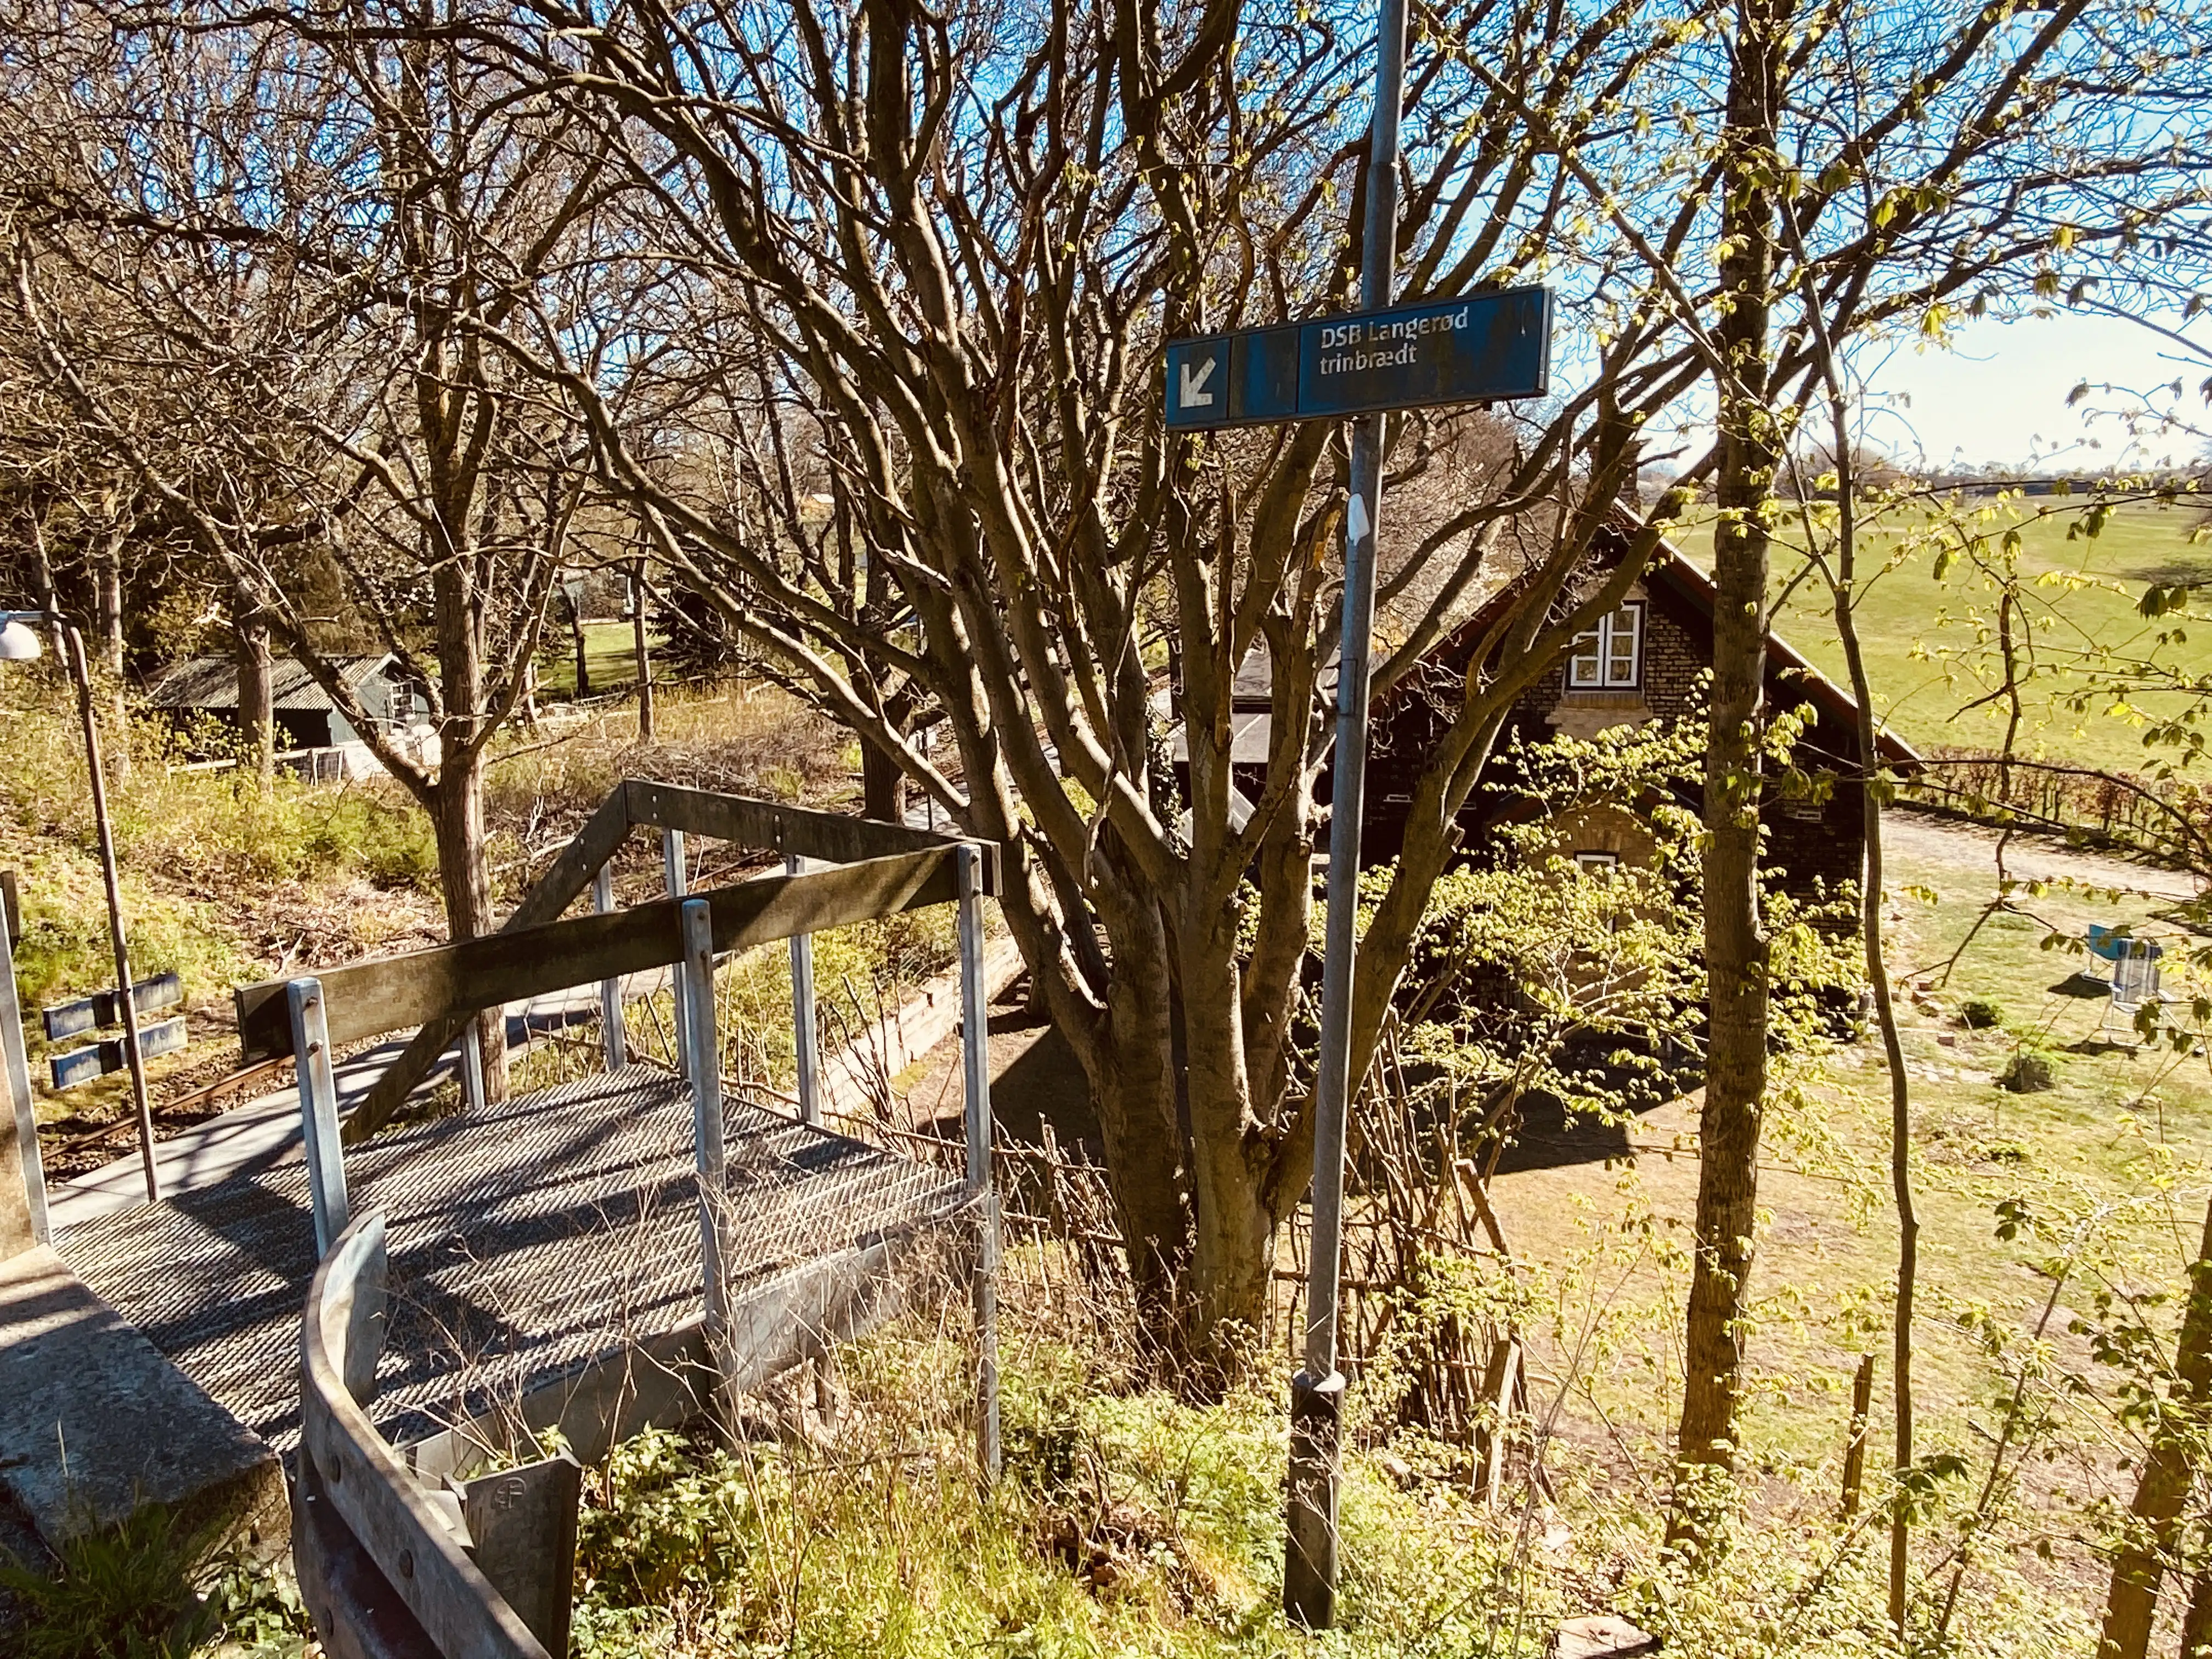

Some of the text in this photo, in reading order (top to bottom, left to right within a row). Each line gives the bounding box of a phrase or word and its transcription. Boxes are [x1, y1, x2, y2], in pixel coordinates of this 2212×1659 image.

[1321, 306, 1469, 349] DSB Langerød
[1320, 342, 1418, 375] trinbrædt
